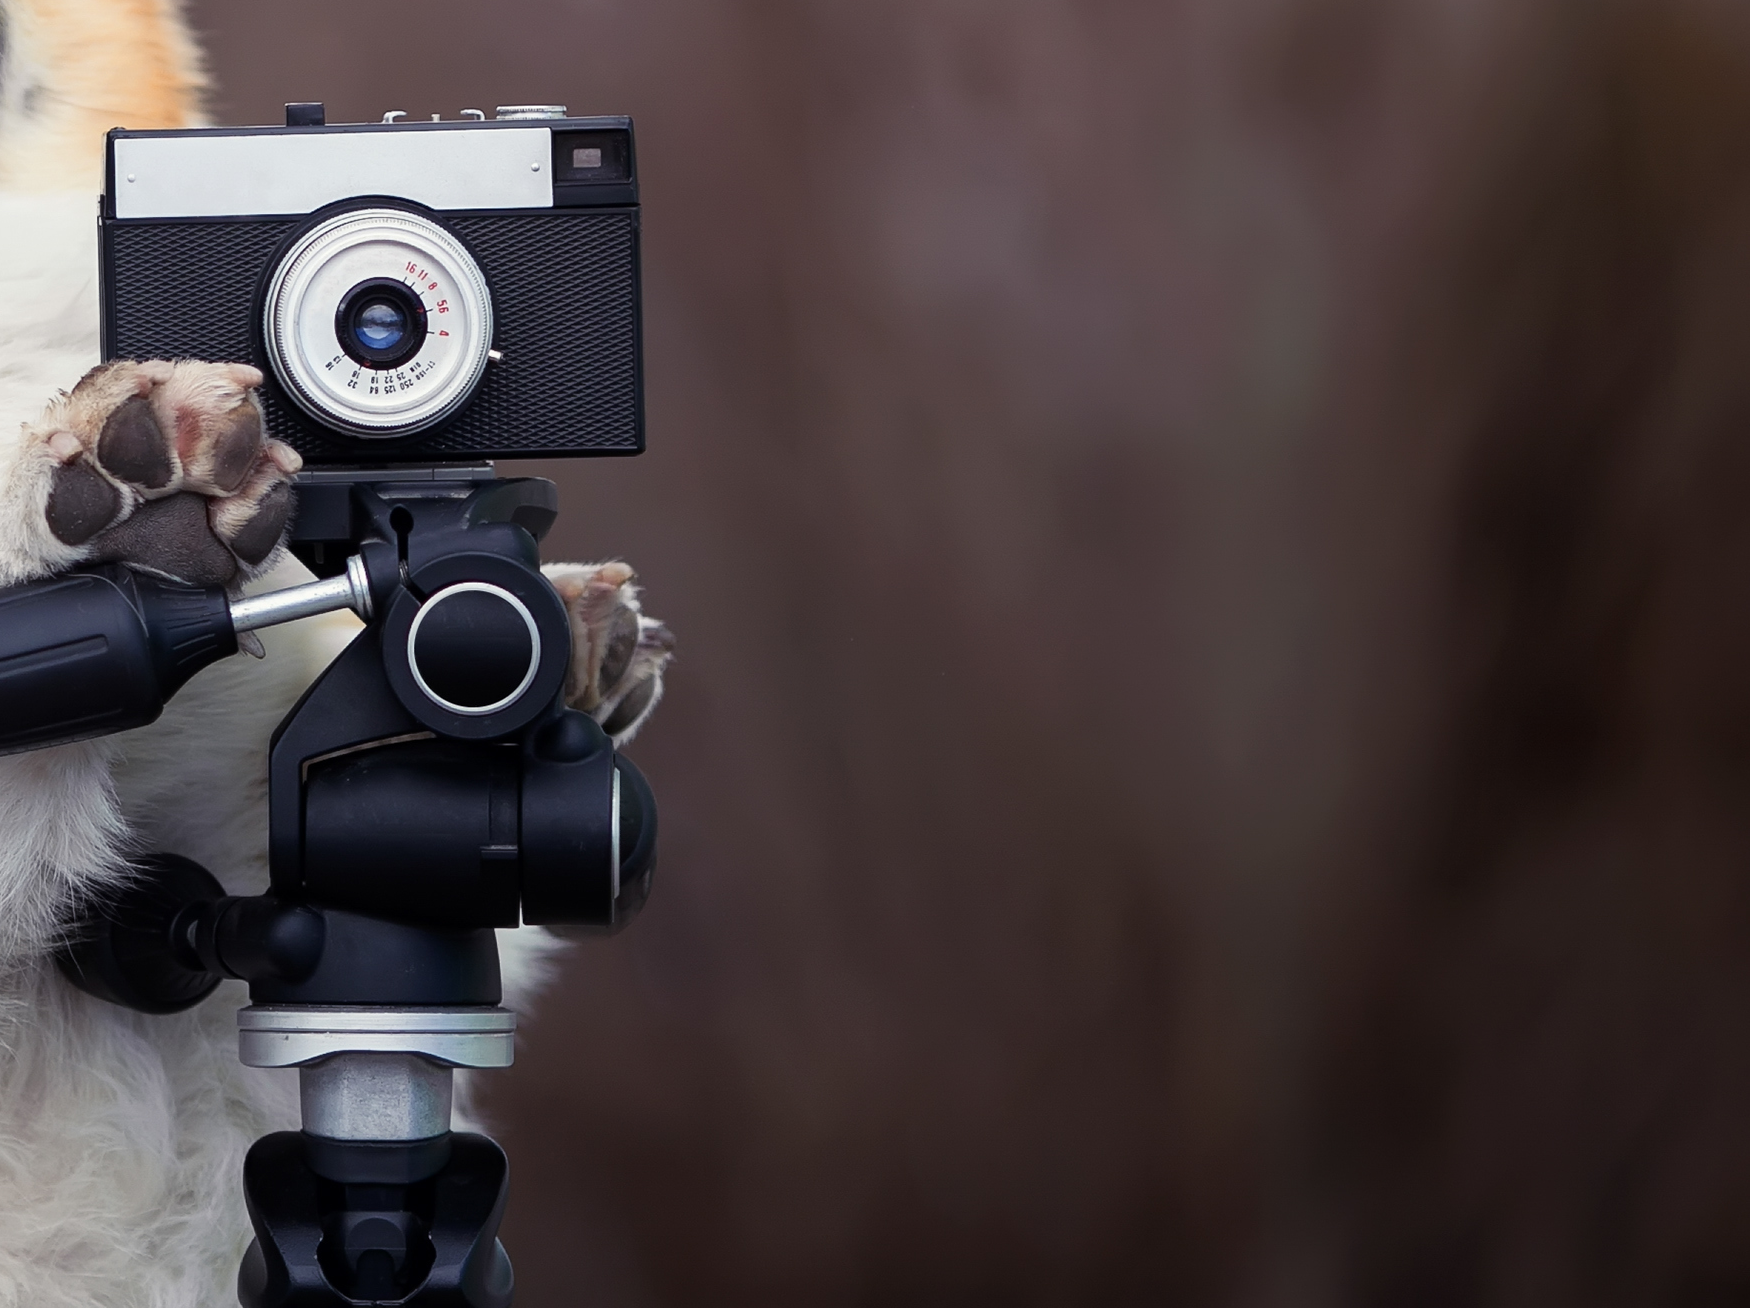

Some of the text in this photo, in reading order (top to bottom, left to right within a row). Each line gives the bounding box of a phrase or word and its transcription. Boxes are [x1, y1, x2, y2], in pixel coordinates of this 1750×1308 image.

[406, 261, 417, 274] 16
[418, 269, 428, 281] 11
[428, 282, 438, 291] 8
[384, 376, 393, 384] 22
[397, 372, 406, 381] 25
[347, 380, 358, 389] 32
[400, 379, 414, 390] 250
[384, 385, 396, 394] 125
